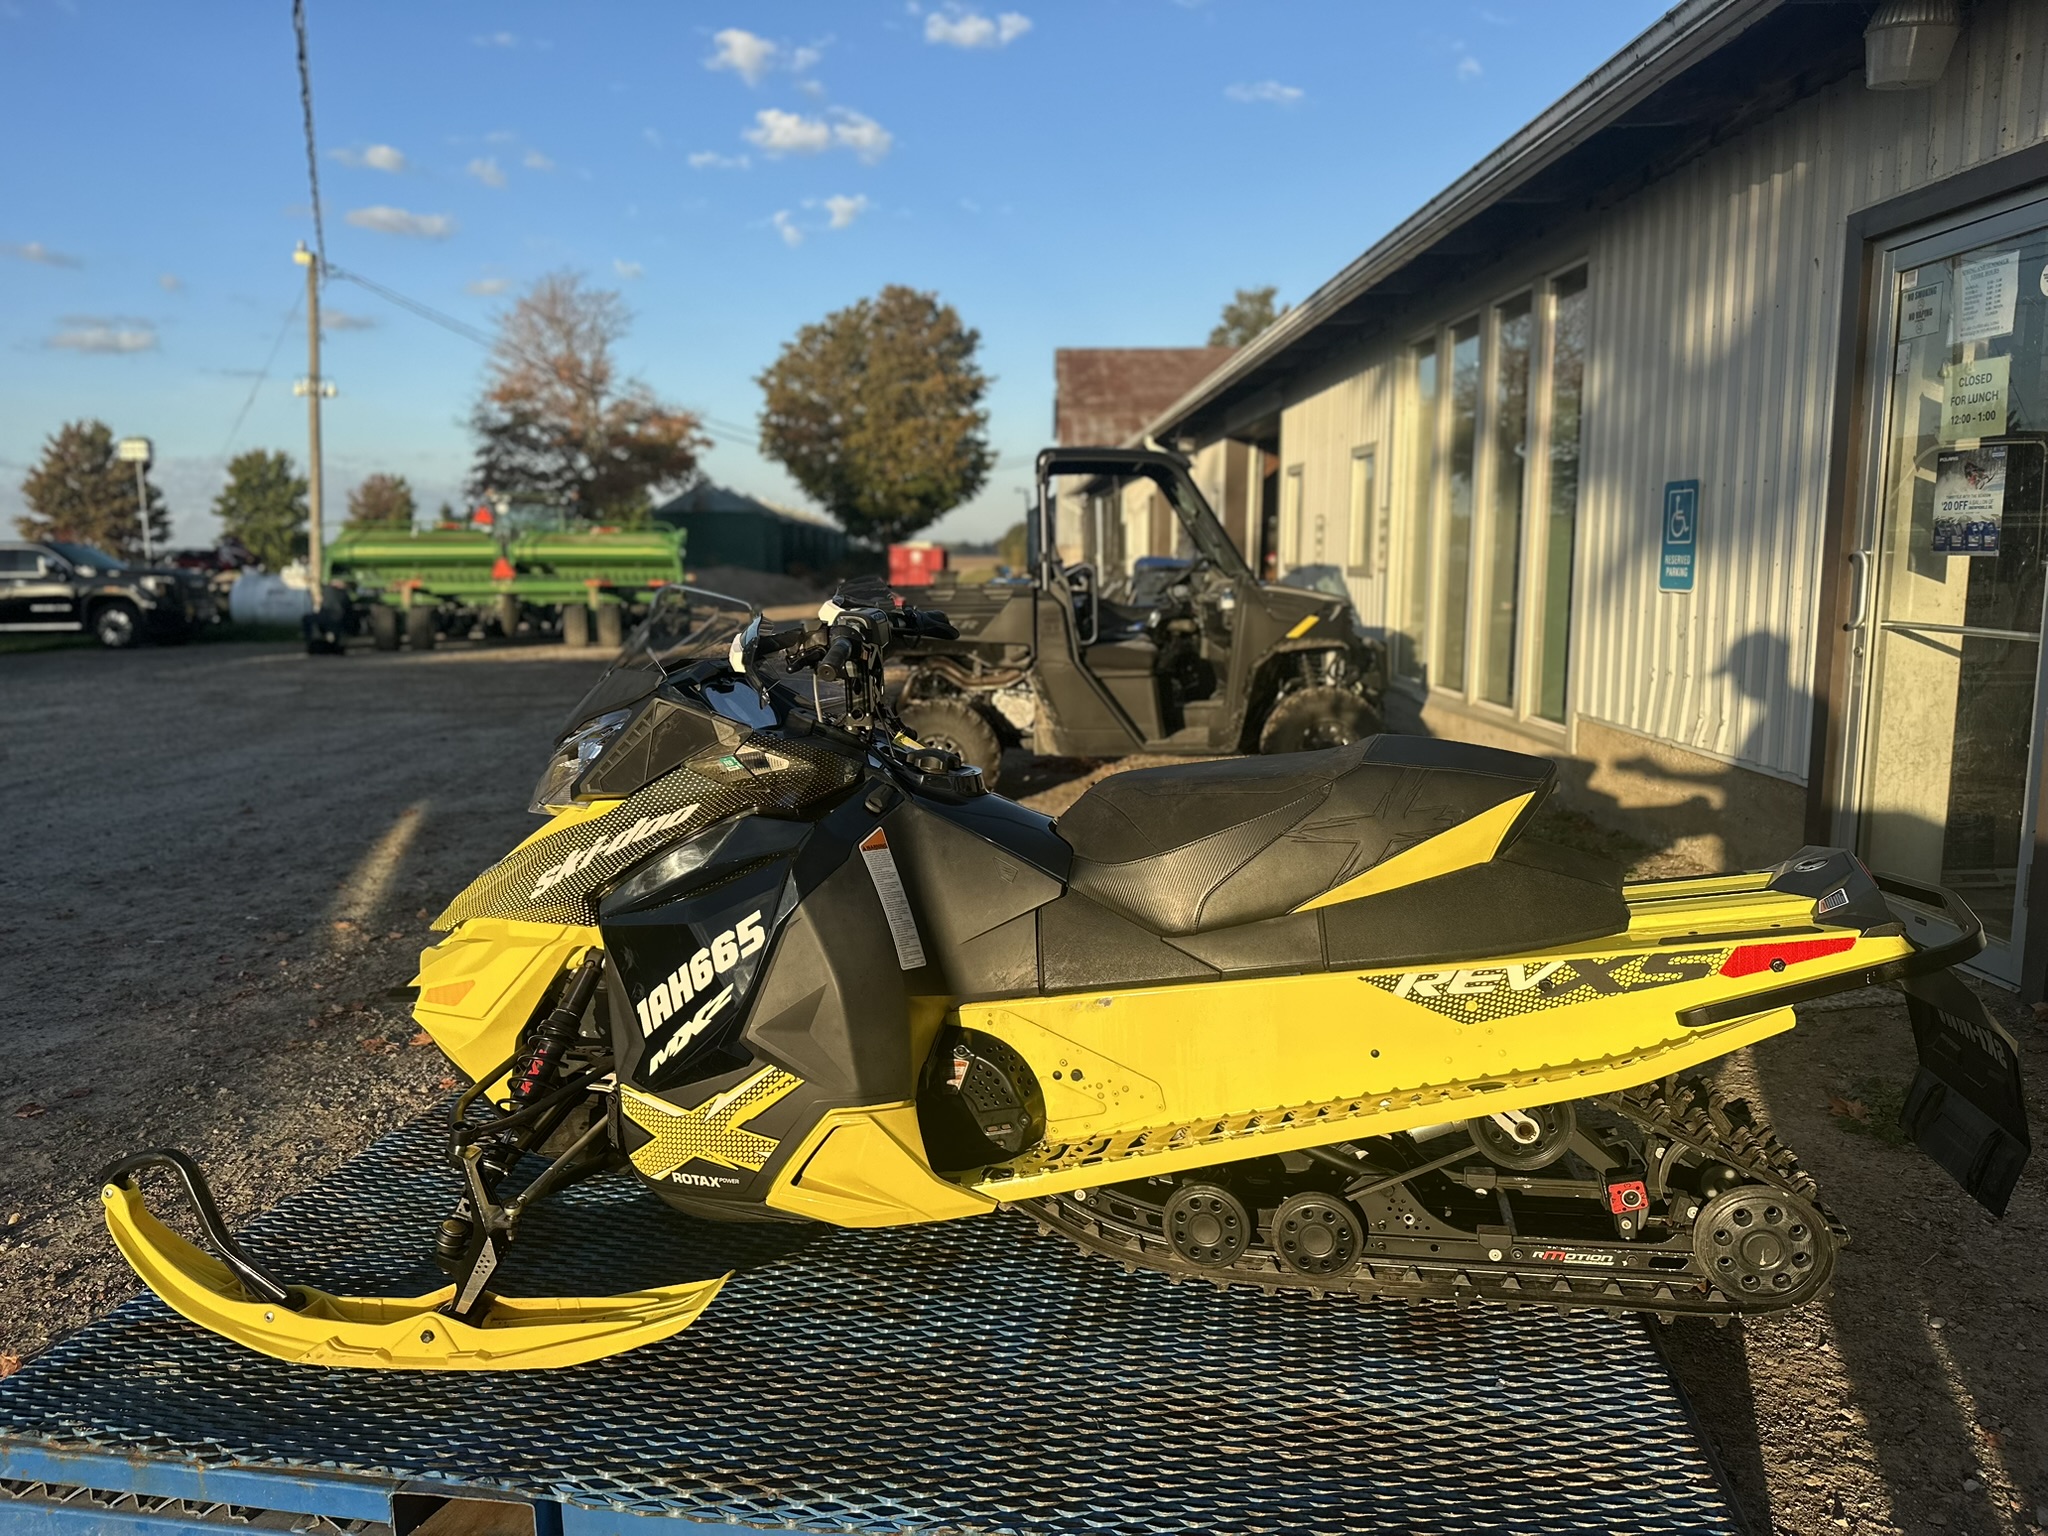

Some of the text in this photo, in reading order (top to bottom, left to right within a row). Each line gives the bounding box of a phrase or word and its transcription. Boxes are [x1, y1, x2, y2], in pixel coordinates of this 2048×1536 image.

[1958, 372, 1993, 388] CLOSED
[1950, 391, 1999, 407] FOR LUNCH
[1950, 413, 1971, 425] 12:00
[1977, 410, 1996, 422] 1:00
[1953, 500, 1969, 510] OFF
[1664, 554, 1691, 565] RESERVED
[1665, 567, 1688, 577] PARKING
[636, 909, 766, 1039] 1AH665
[1392, 959, 1567, 998] REV
[648, 983, 734, 1077] MXZ
[670, 1171, 740, 1188] ROTAX POWER
